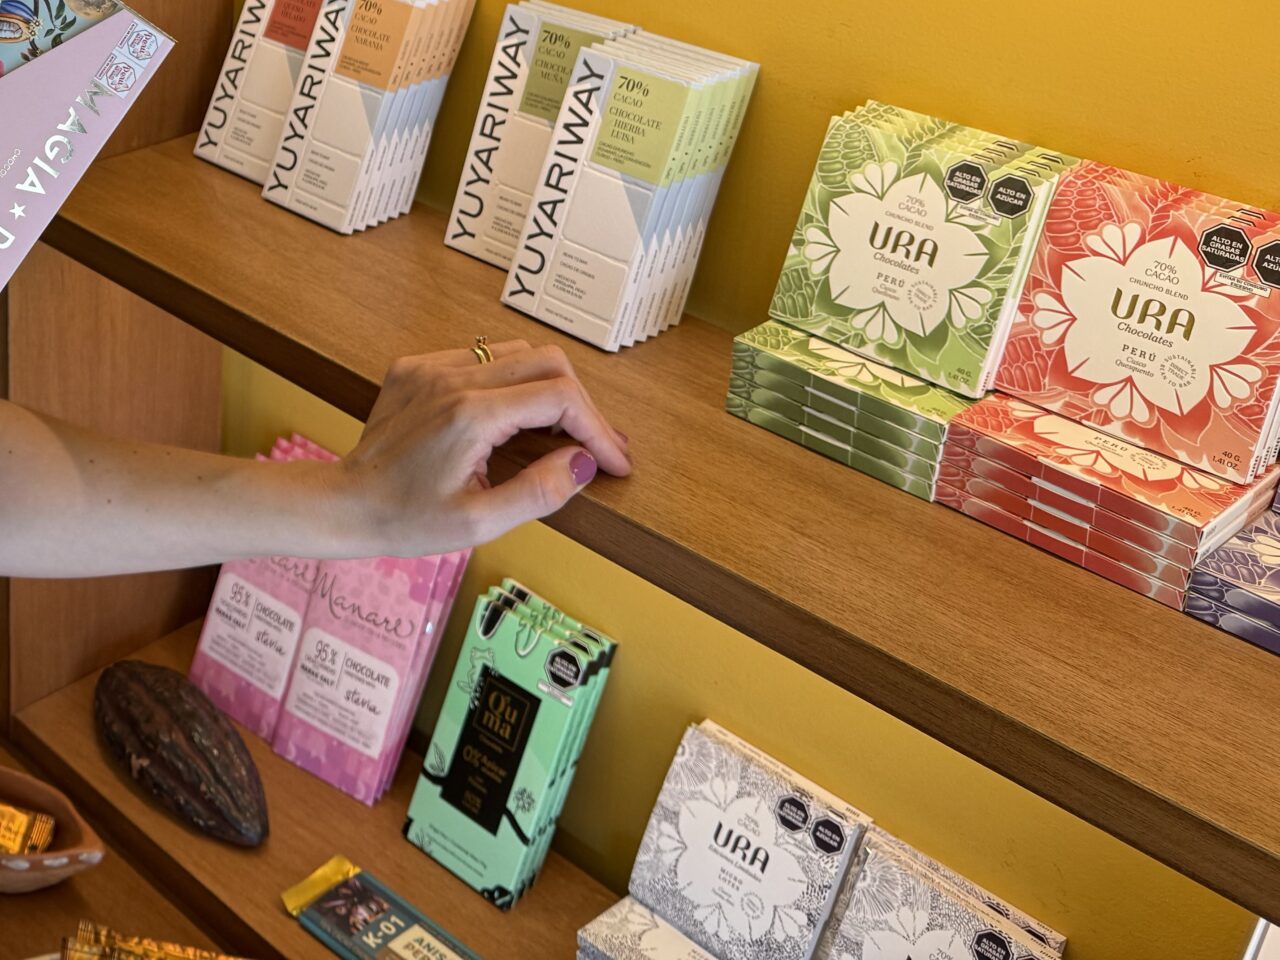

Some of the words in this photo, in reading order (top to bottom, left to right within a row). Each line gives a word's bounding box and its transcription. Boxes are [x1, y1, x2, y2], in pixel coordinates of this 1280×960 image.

[354, 13, 378, 25] CACAO
[351, 25, 391, 42] CHOCOLATE
[542, 30, 571, 49] 70%
[354, 35, 384, 52] NARANJA
[538, 46, 566, 59] CACAO
[540, 70, 564, 85] MUÑA
[618, 75, 649, 97] 70%
[613, 92, 643, 108] CACAO
[609, 107, 662, 130] CHOCOLATE
[451, 15, 530, 240] YUYARIWAY
[614, 120, 645, 137] HIERBA
[15, 79, 113, 195] MAGIA
[611, 129, 634, 144] LUISA
[508, 58, 605, 299] YUYARIWAY
[953, 175, 978, 188] GRASAS
[956, 170, 969, 180] ALTO
[971, 175, 981, 183] EN
[947, 180, 982, 195] SATURADAS
[998, 186, 1014, 197] ALTO
[1016, 190, 1026, 199] EN
[905, 195, 926, 208] 70%
[995, 193, 1024, 206] AZÚCAR
[898, 202, 928, 217] CACAO
[885, 210, 914, 224] CHUNCHO
[914, 221, 934, 231] BLEND
[869, 221, 938, 269] URA
[1209, 241, 1240, 255] GRASAS
[1211, 235, 1231, 245] ALTO
[1232, 240, 1243, 249] EN
[1201, 245, 1245, 263] SATURADAS
[873, 252, 920, 275] Chocolates
[1153, 260, 1177, 275] 70%
[876, 272, 906, 288] PERÚ
[1144, 268, 1180, 285] CACAO
[1129, 277, 1164, 293] CHUNCHO
[1165, 288, 1188, 301] BLEND
[1111, 288, 1196, 342] URA
[1117, 322, 1174, 348] Chocolates
[1122, 344, 1157, 362] PERÚ
[1126, 356, 1147, 368] Cusco
[1164, 354, 1197, 381] SUSTAINABLE
[1170, 362, 1189, 376] DIRECT
[1167, 367, 1184, 381] TRADE
[1168, 379, 1176, 387] TO
[1179, 380, 1192, 388] BAR
[1212, 455, 1226, 467] 1.41
[1226, 461, 1240, 471] OZ.
[1222, 450, 1233, 459] 40
[1233, 455, 1242, 463] G.
[231, 582, 252, 607] 95%
[256, 603, 295, 633] CHOCOLATE
[314, 640, 337, 665] 95%
[345, 657, 390, 688] CHOCOLATE
[713, 821, 770, 875] URA
[362, 915, 406, 949] K-01
